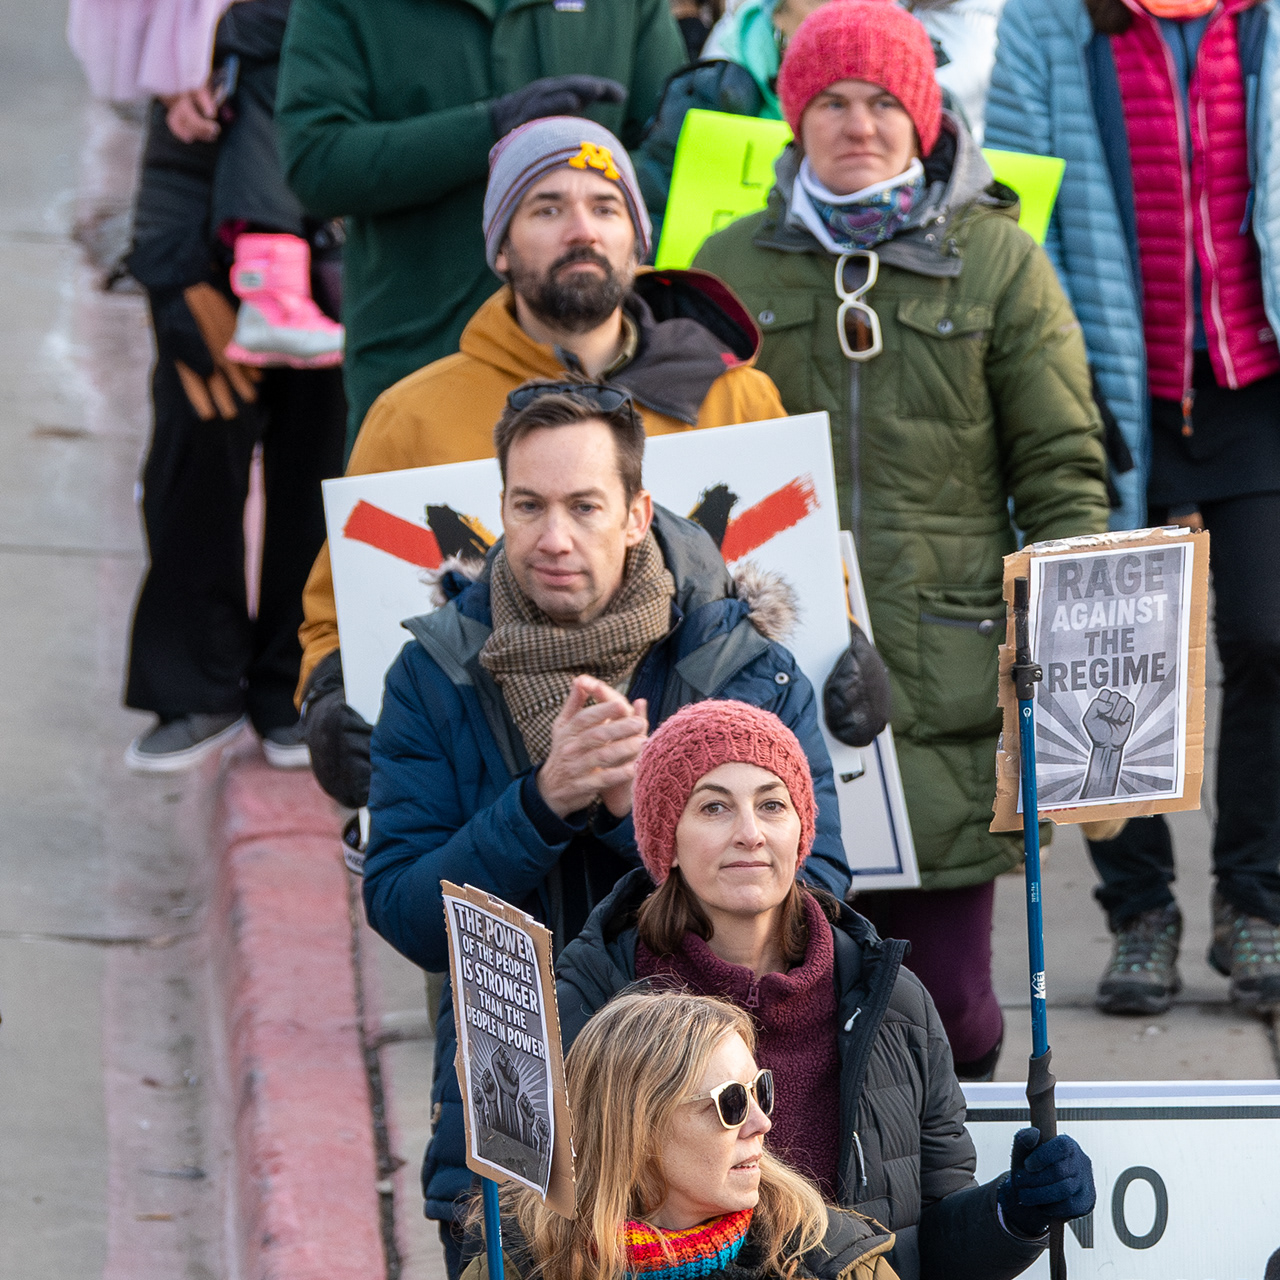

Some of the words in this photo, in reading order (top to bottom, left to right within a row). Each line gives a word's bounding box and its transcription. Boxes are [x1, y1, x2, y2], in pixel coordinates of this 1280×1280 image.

[1057, 551, 1165, 602] RAGE
[1050, 594, 1168, 633] AGAINST
[1084, 627, 1135, 657] THE
[1048, 652, 1167, 693] REGIME
[455, 905, 483, 938] THE
[486, 915, 534, 962] POWER
[462, 934, 475, 954] OF
[476, 939, 494, 967] THE
[495, 946, 533, 984] PEOPLE
[462, 955, 474, 981] IS
[475, 961, 540, 1014] STRONGER
[466, 1004, 497, 1040] PEOPLE
[497, 1020, 506, 1044] IN
[506, 1024, 546, 1060] POWER
[478, 990, 503, 1020] THAN
[504, 999, 528, 1030] THE
